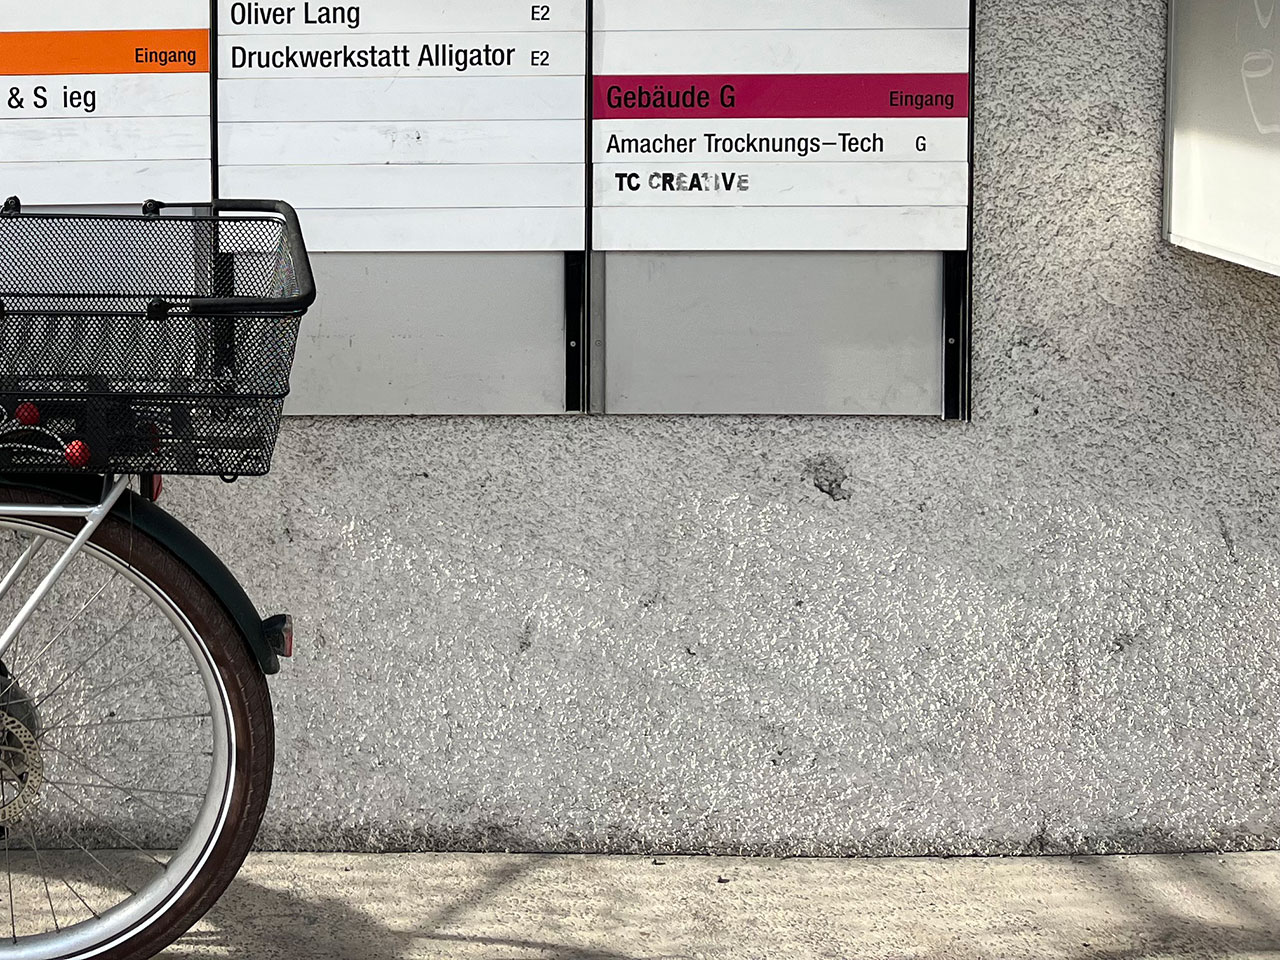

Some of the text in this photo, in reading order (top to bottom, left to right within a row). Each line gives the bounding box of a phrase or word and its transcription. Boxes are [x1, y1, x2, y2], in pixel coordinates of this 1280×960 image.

[231, 2, 549, 28] Oliver Lang E2
[136, 48, 196, 66] Eingang
[232, 44, 549, 71] Druckwerkstatt Alligator E2
[8, 87, 24, 108] &
[607, 85, 954, 109] Gebäude G Eingang
[606, 134, 696, 153] Amacher
[916, 136, 926, 151] G
[615, 173, 640, 191] TC
